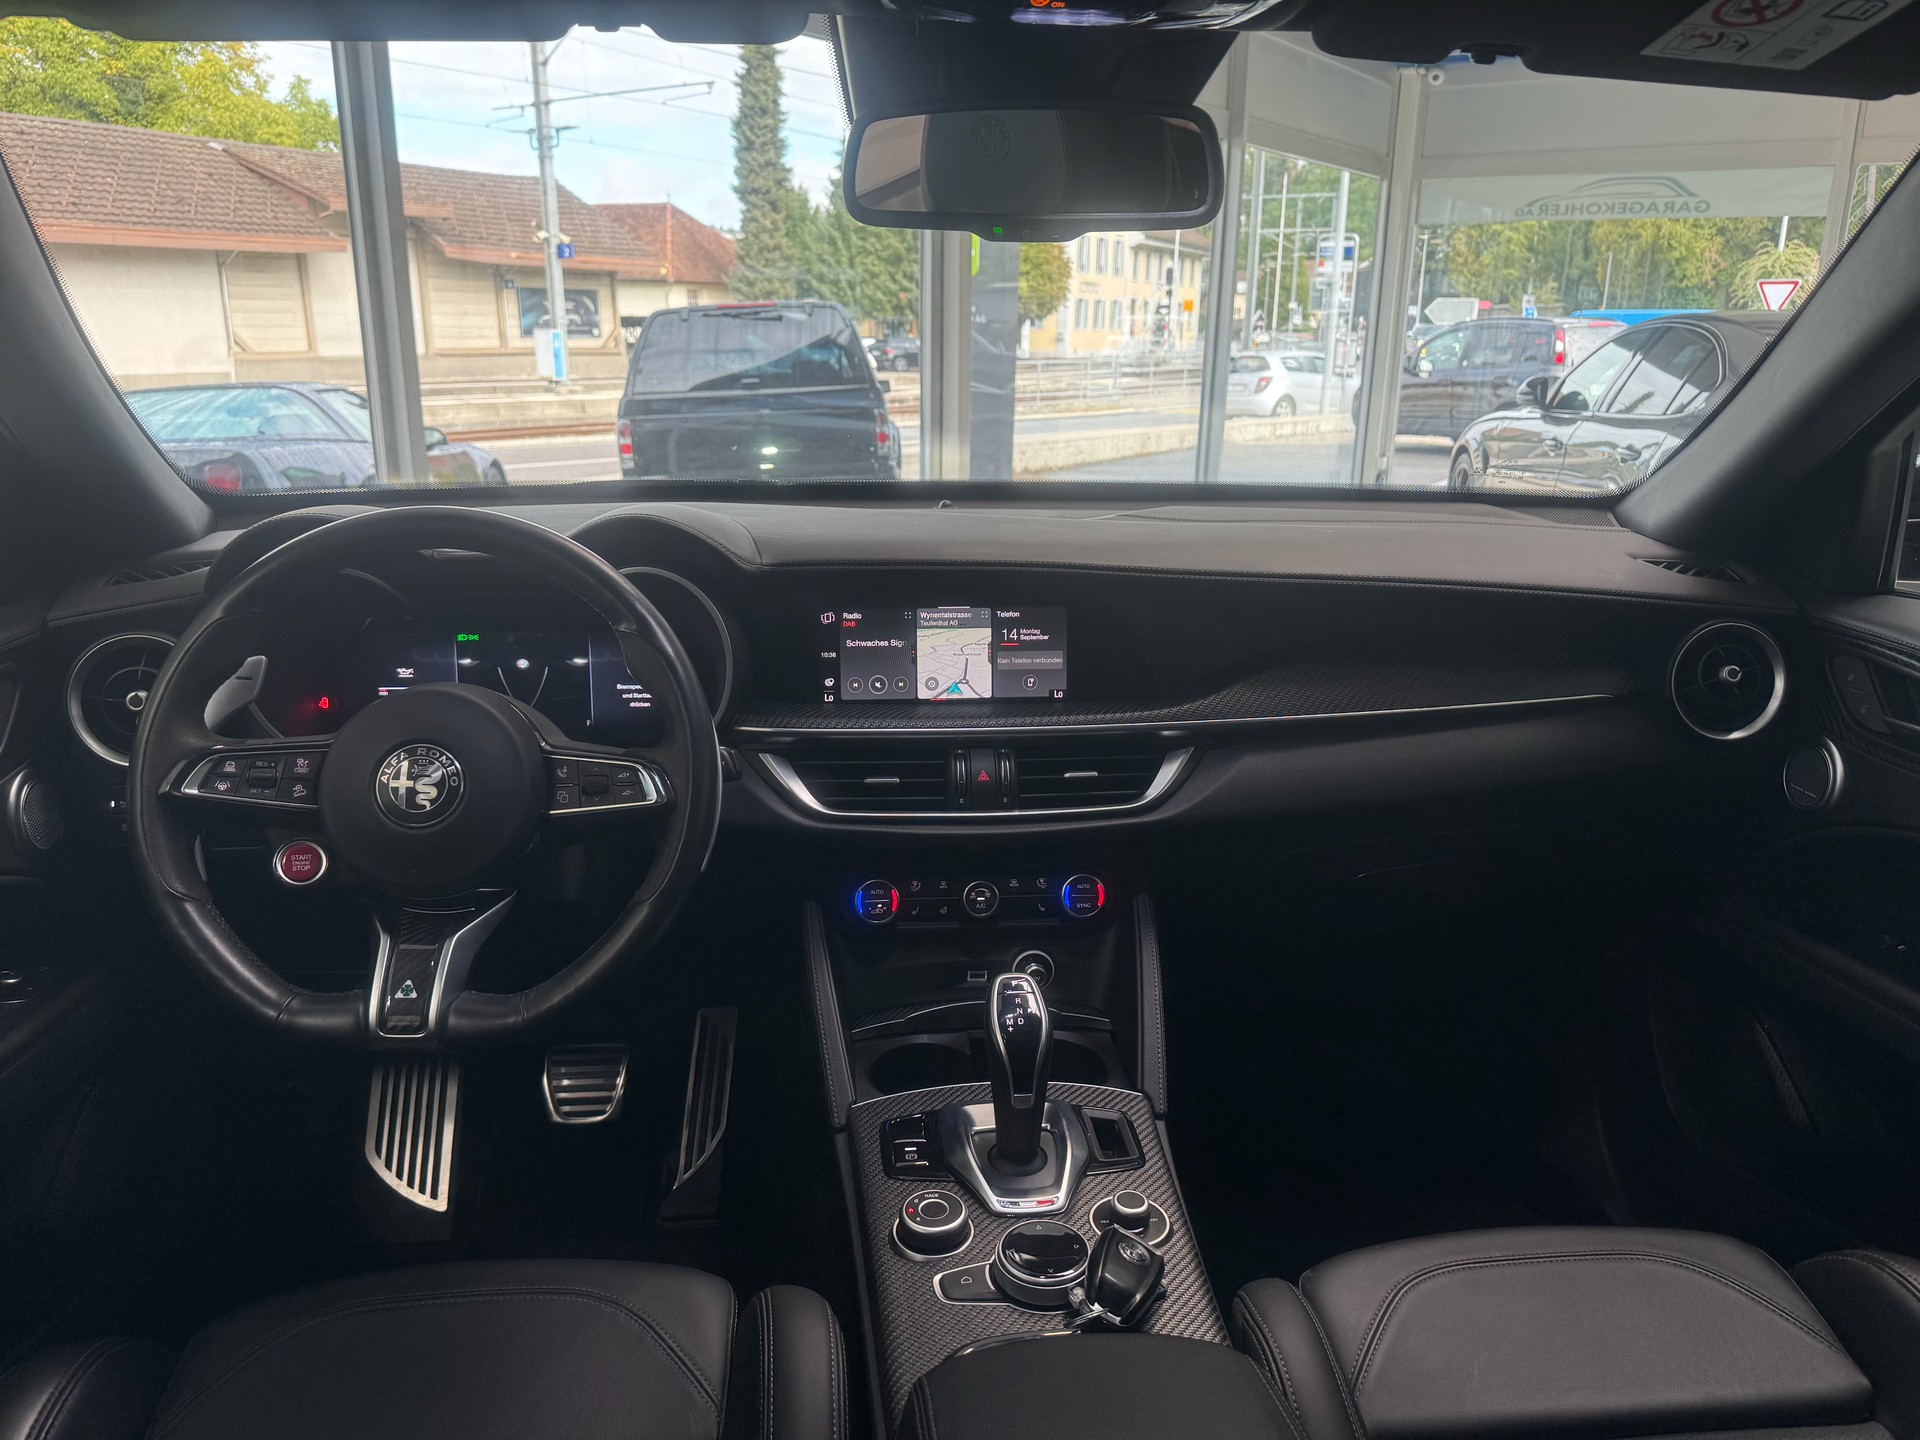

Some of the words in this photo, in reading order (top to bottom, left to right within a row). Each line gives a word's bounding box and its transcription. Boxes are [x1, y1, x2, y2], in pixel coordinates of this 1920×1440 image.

[919, 611, 973, 619] Wynentalstrasse
[1001, 628, 1019, 641] 14
[846, 639, 889, 647] Schwaches
[824, 693, 834, 702] Lo
[1053, 690, 1064, 698] Lo
[380, 751, 410, 784] ALFA
[416, 747, 459, 787] ROMEO
[1015, 997, 1022, 1005] R
[1016, 1007, 1024, 1015] N
[1006, 1018, 1014, 1026] M
[1017, 1017, 1025, 1025] D
